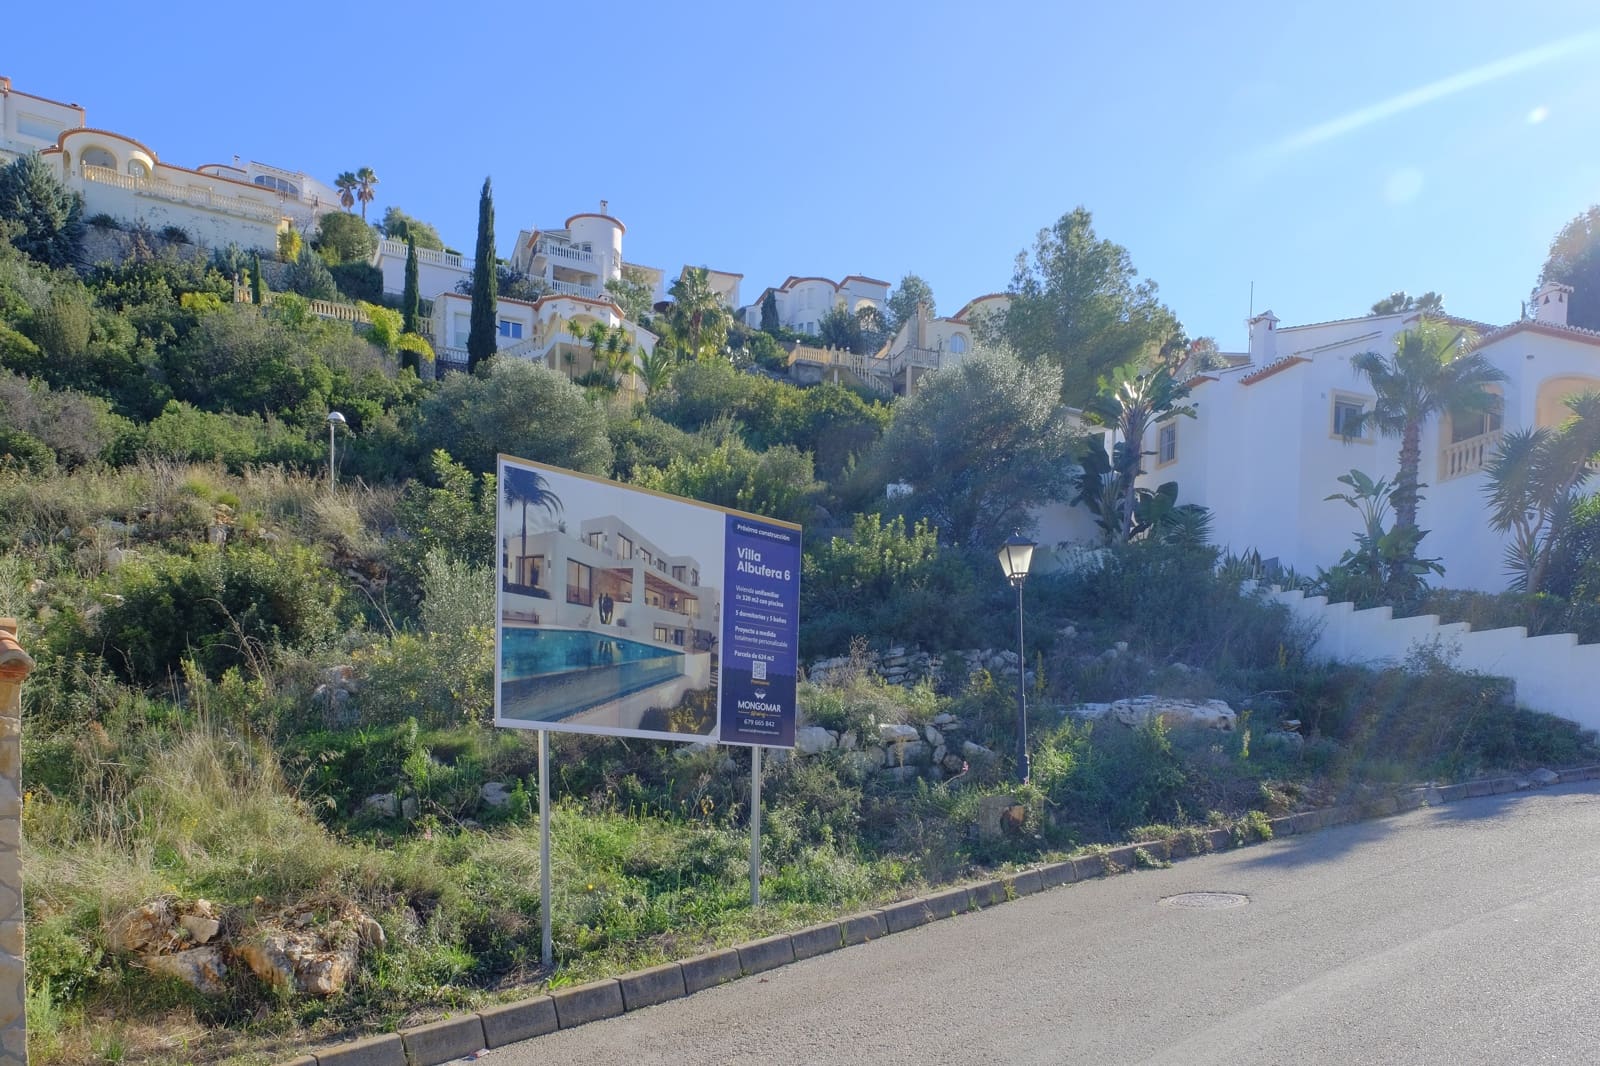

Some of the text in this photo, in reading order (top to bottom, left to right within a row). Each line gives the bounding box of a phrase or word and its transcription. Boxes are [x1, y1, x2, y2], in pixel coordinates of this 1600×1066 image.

[737, 524, 790, 541] Próxima construcción
[737, 547, 761, 562] Villa
[737, 560, 791, 581] Albufera 6
[754, 590, 779, 598] unifamiliar
[739, 610, 766, 620] dormitorios
[773, 616, 786, 624] baños
[735, 626, 755, 634] Proyecto
[759, 638, 788, 648] personalizable
[738, 700, 781, 712] MONGOMAR
